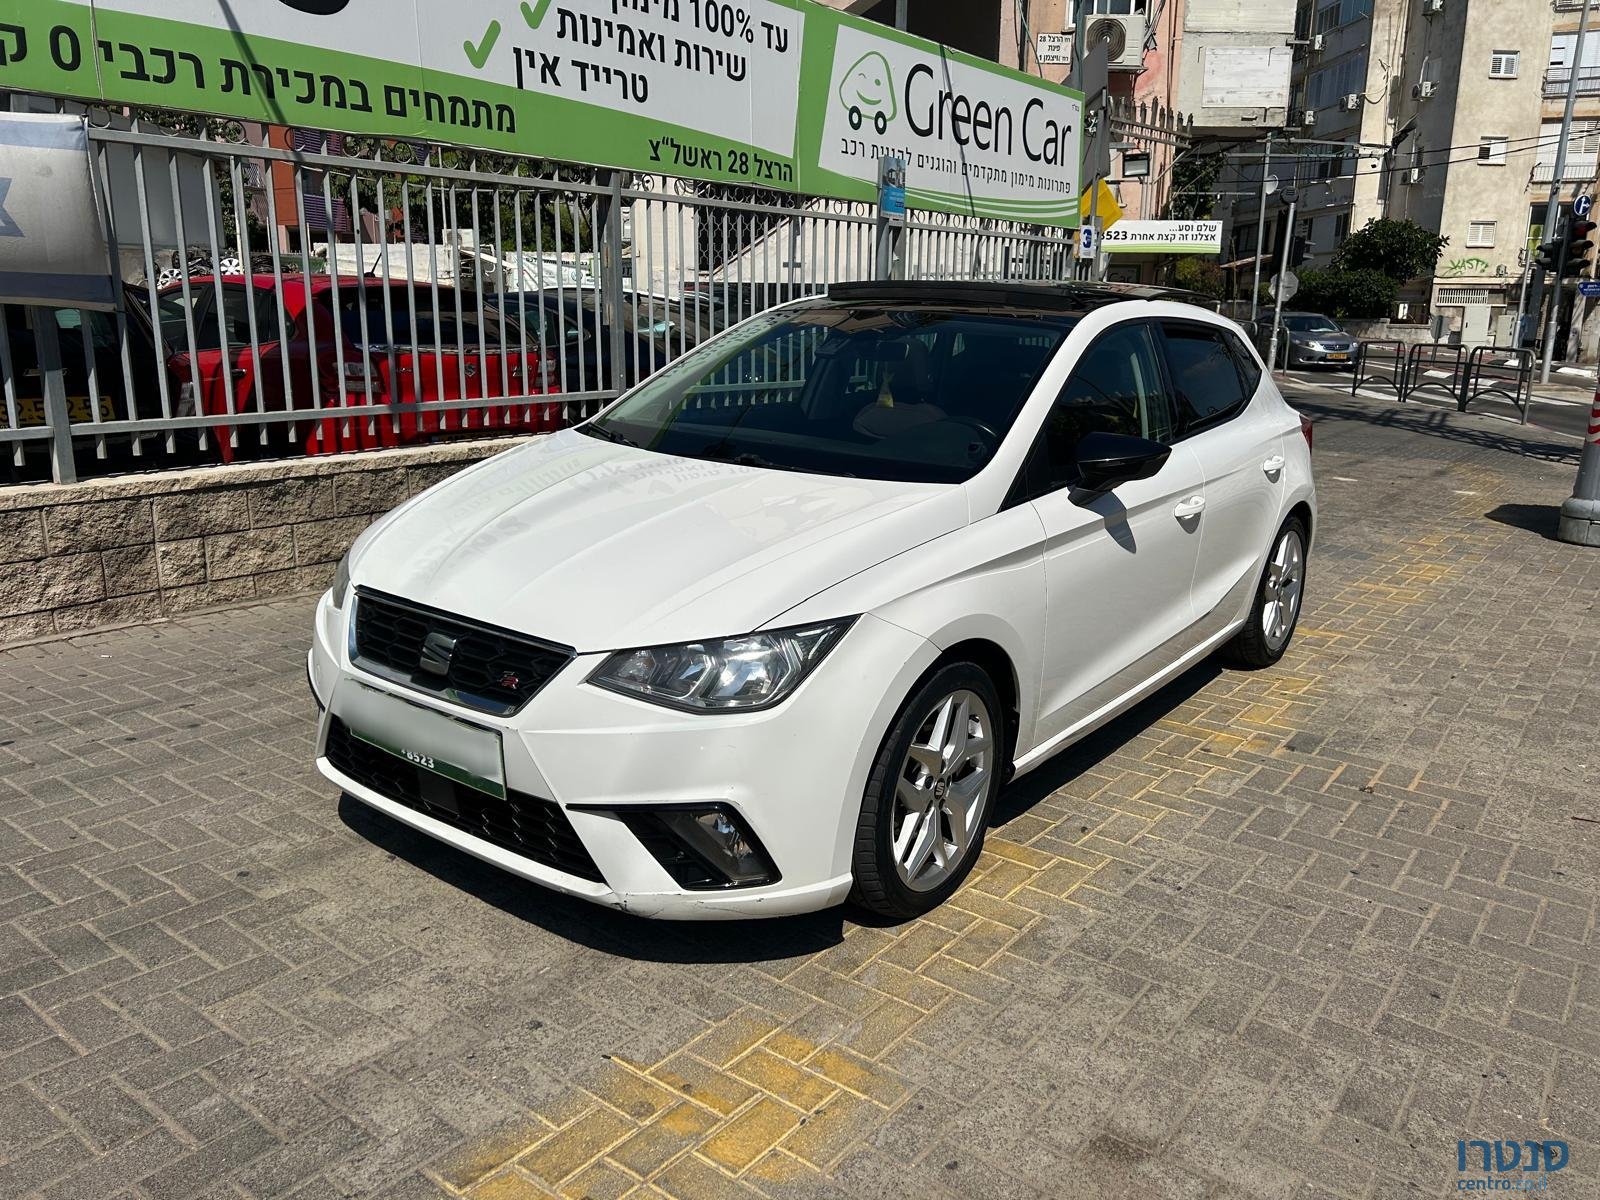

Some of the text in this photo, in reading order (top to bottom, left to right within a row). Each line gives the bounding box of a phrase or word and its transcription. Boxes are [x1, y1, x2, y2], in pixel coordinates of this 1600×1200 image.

[556, 7, 666, 63] ואמינות
[689, 0, 755, 44] 100%
[49, 24, 81, 71] 0
[761, 21, 789, 53] עד
[97, 39, 206, 89] רכבי
[675, 38, 747, 82] שירות
[219, 58, 373, 113] במכירת
[513, 47, 648, 103] טרייד אין
[384, 85, 516, 133] מתמחים
[904, 63, 1072, 167] Green Car
[727, 149, 749, 175] 28
[840, 138, 865, 158] רכב
[753, 152, 793, 182] הרצל
[917, 153, 957, 174] והוגנים
[961, 162, 1007, 184] מתקדמים
[1010, 171, 1035, 188] מימון
[1037, 176, 1071, 194] פתרונות
[1130, 233, 1154, 241] אחרת
[1157, 233, 1176, 243] קצת
[1178, 233, 1188, 241] זה
[1191, 232, 1216, 241] אצלנו
[1196, 223, 1217, 232] שלם
